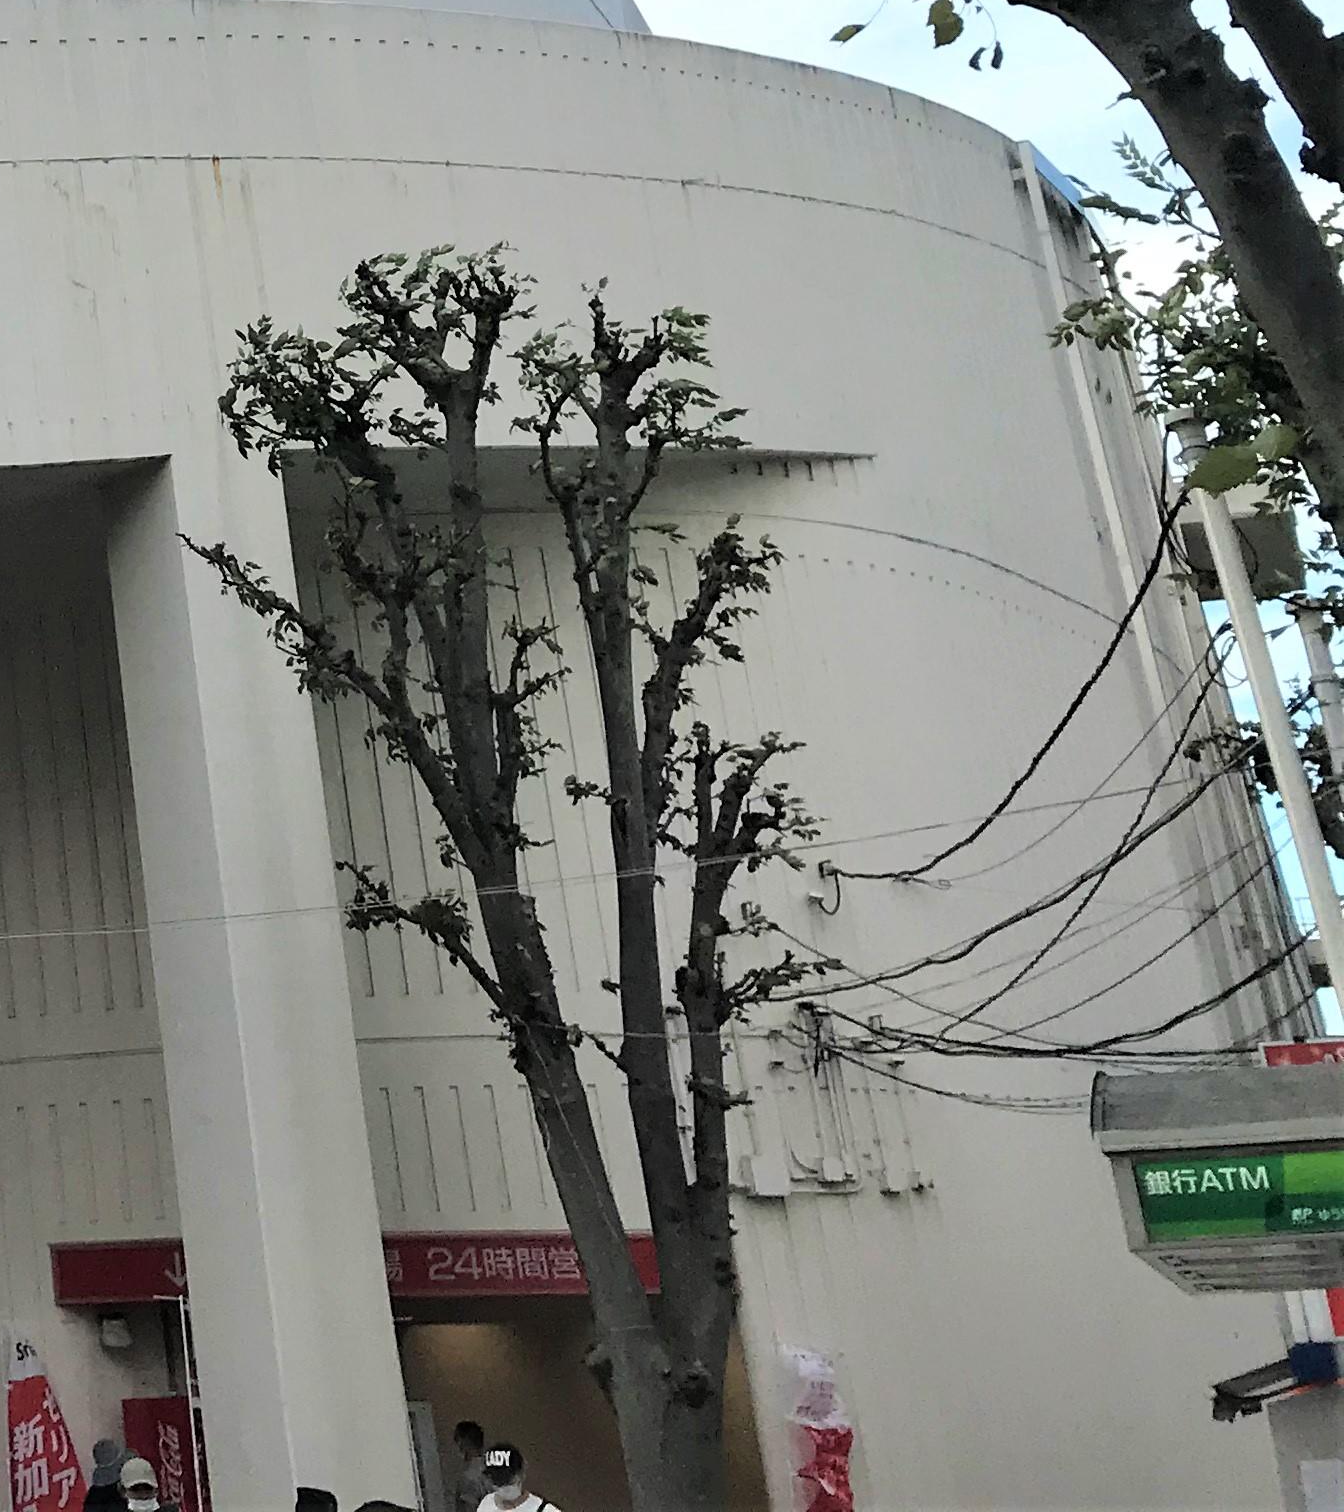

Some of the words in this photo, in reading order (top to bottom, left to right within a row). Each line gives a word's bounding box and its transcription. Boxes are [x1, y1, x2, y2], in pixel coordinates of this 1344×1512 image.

[1144, 1165, 1271, 1195] 銀行ATM
[427, 1247, 581, 1281] 24時間営
[12, 1413, 50, 1512] 新加
[43, 1387, 78, 1508] セリア
